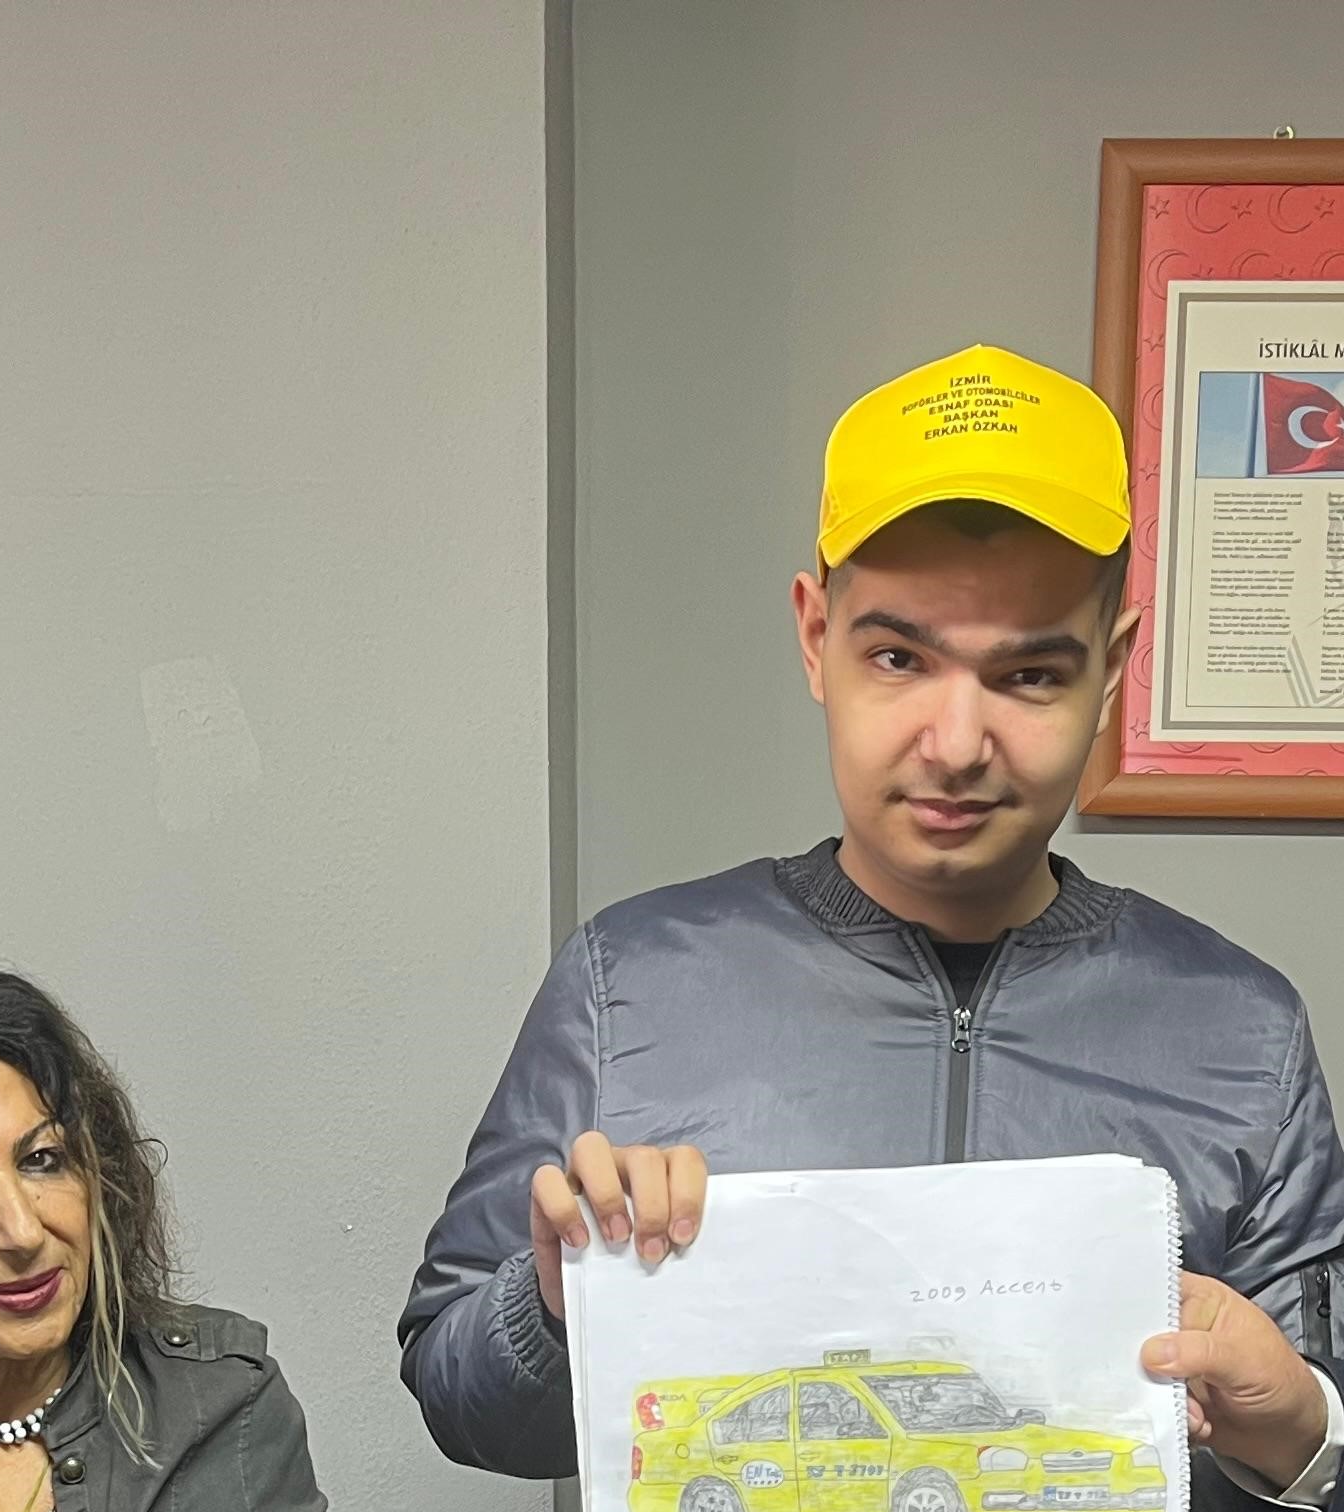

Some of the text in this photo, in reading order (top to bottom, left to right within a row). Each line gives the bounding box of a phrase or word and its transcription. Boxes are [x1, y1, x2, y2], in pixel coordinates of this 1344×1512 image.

[1258, 337, 1329, 359] İSTİKLÂL
[949, 373, 991, 388] İZMİR
[950, 388, 964, 399] VE
[928, 398, 1014, 416] ESNAF ODASI
[943, 409, 999, 423] BAŞKAN
[924, 420, 1018, 440] ERKAN ÖZKAN
